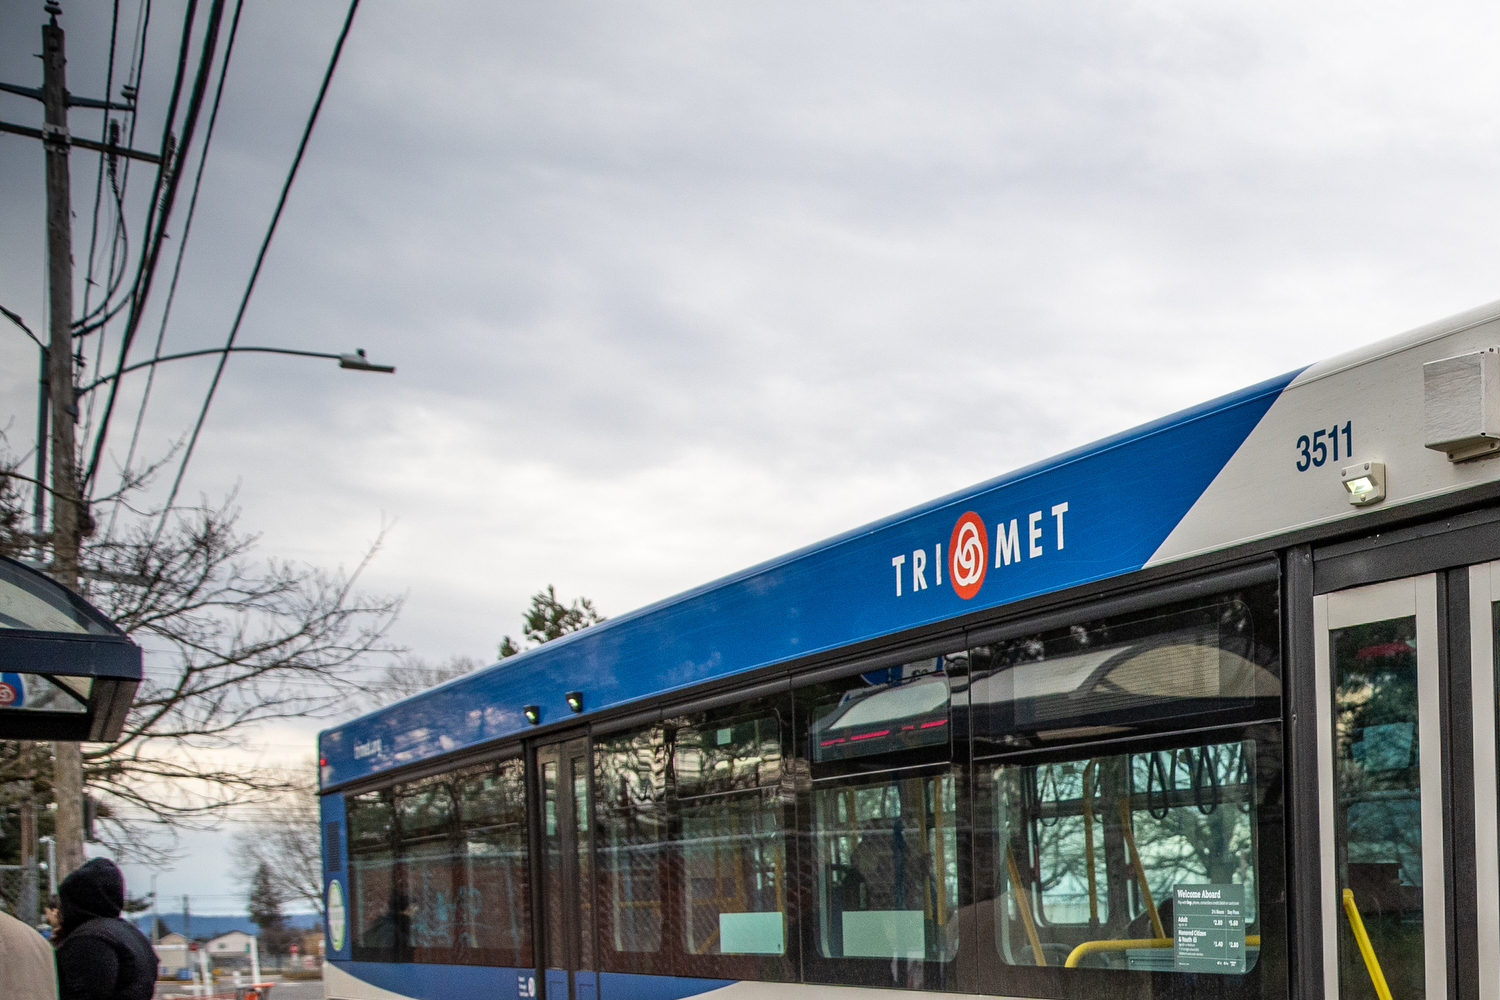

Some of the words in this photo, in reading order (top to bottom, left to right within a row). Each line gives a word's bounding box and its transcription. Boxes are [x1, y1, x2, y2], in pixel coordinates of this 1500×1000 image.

[1296, 420, 1352, 472] 3511
[892, 543, 942, 597] TRI
[995, 502, 1069, 568] MET
[1177, 889, 1201, 899] Welcome
[1201, 889, 1221, 899] Aboard
[1193, 929, 1207, 937] Citizen
